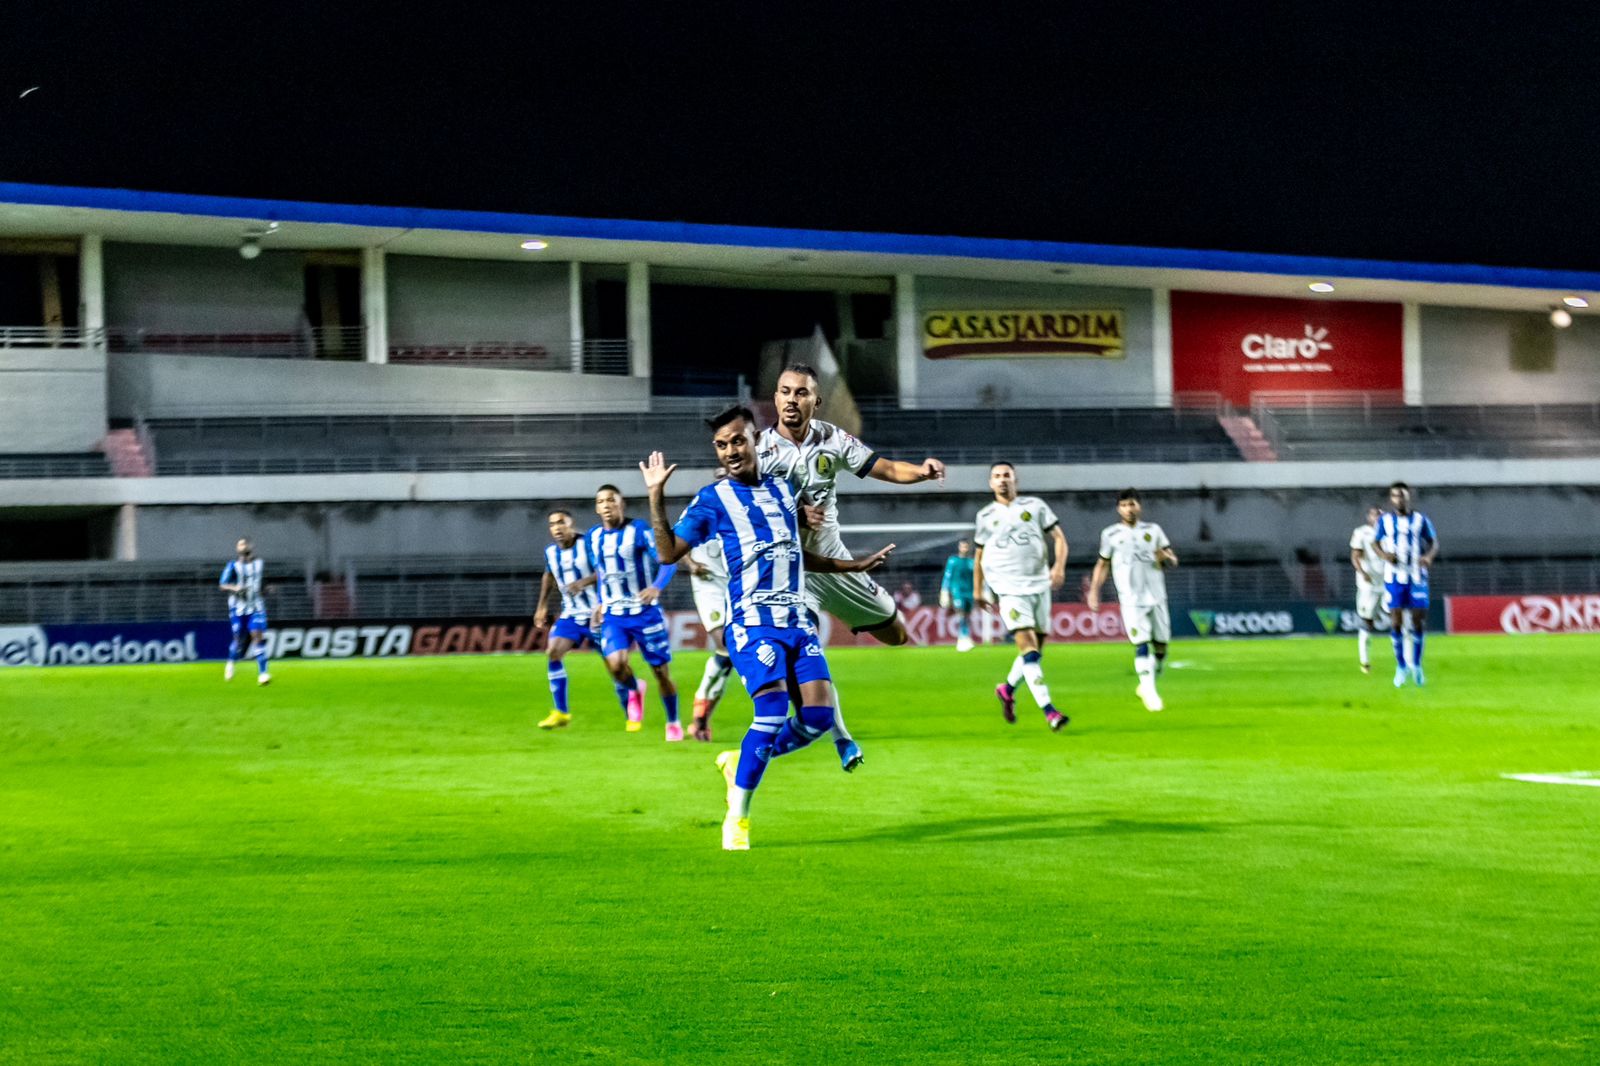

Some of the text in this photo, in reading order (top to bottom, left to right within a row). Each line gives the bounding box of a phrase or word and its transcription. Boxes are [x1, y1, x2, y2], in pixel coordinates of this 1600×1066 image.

[1241, 333, 1319, 359] Claro
[1214, 611, 1294, 633] SICOOB
[244, 624, 549, 658] APOSTA GANHA
